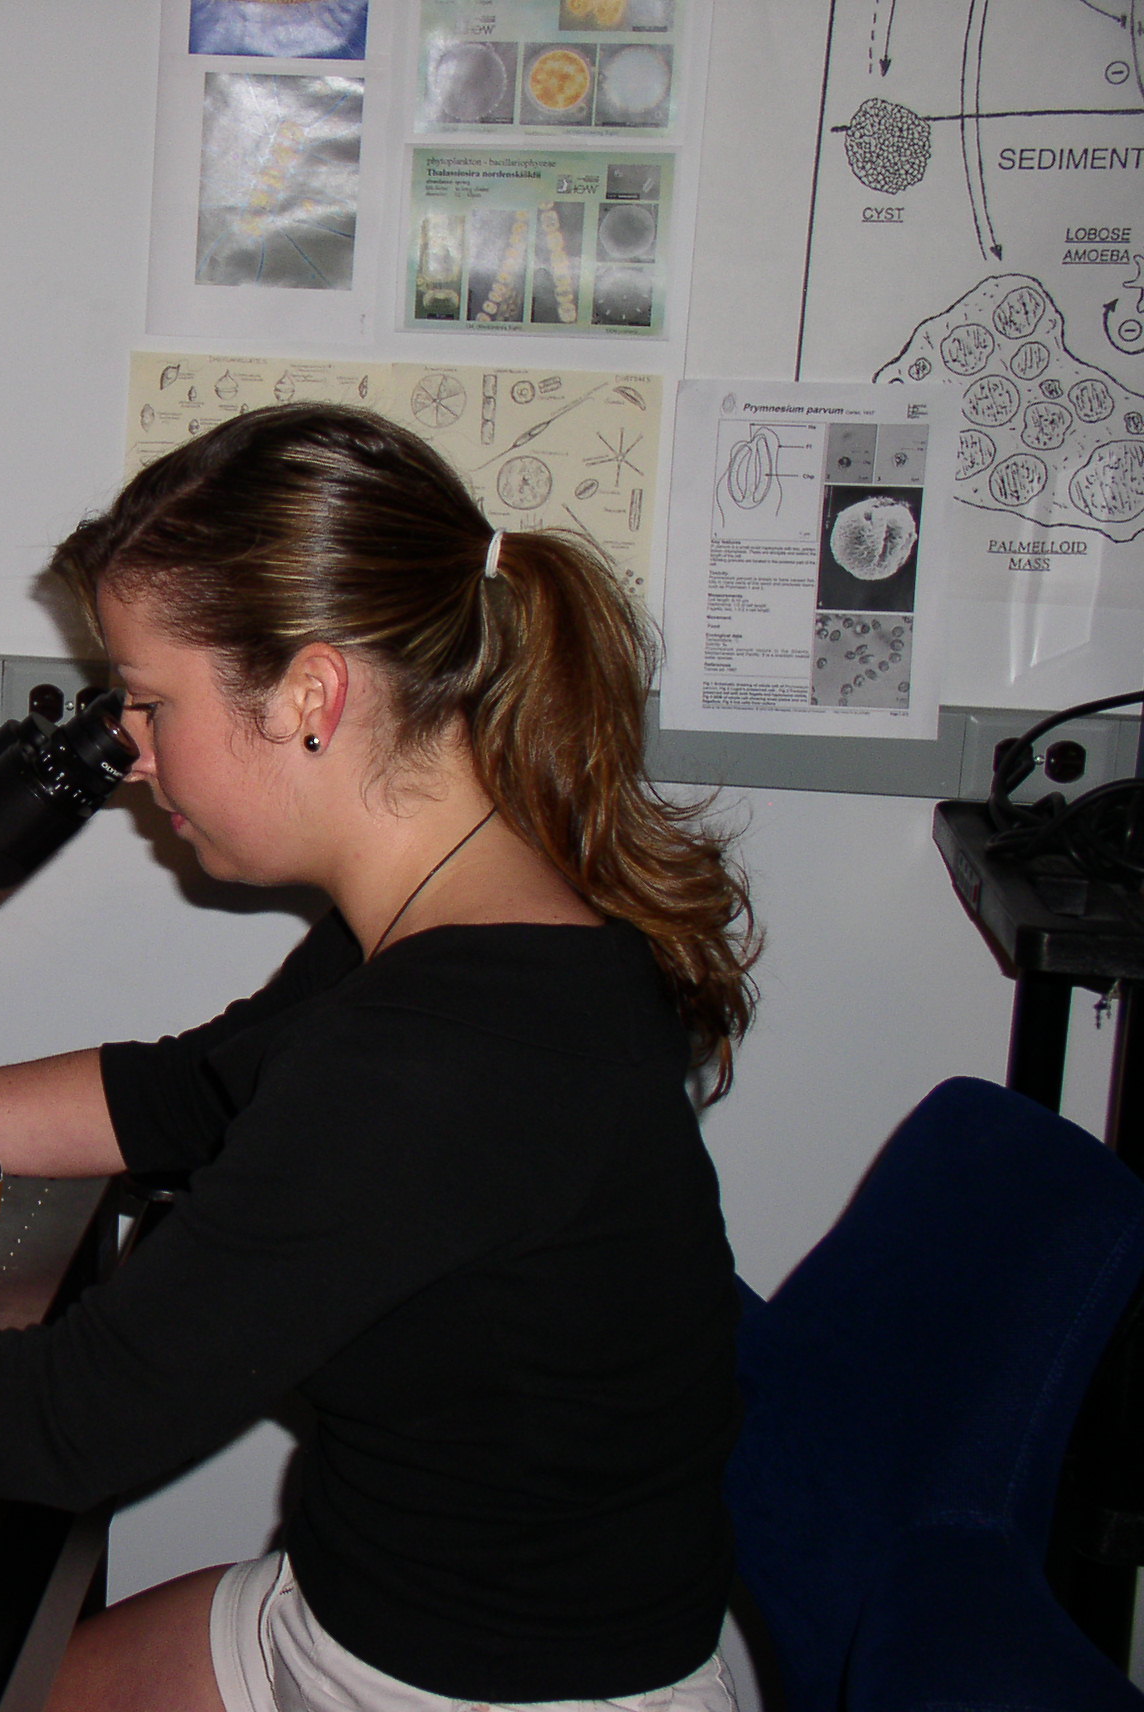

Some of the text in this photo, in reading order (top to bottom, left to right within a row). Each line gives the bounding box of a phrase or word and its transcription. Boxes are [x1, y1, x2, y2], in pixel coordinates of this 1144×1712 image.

[998, 147, 1144, 171] SEDIMENT
[862, 206, 905, 221] CYST
[1064, 227, 1132, 242] LOBOSE
[1062, 249, 1130, 263] AMOEBA
[743, 402, 804, 414] Prymnesium
[806, 406, 844, 416] parvum
[987, 539, 1088, 554] PALMELLOID
[1008, 557, 1051, 571] MASS
